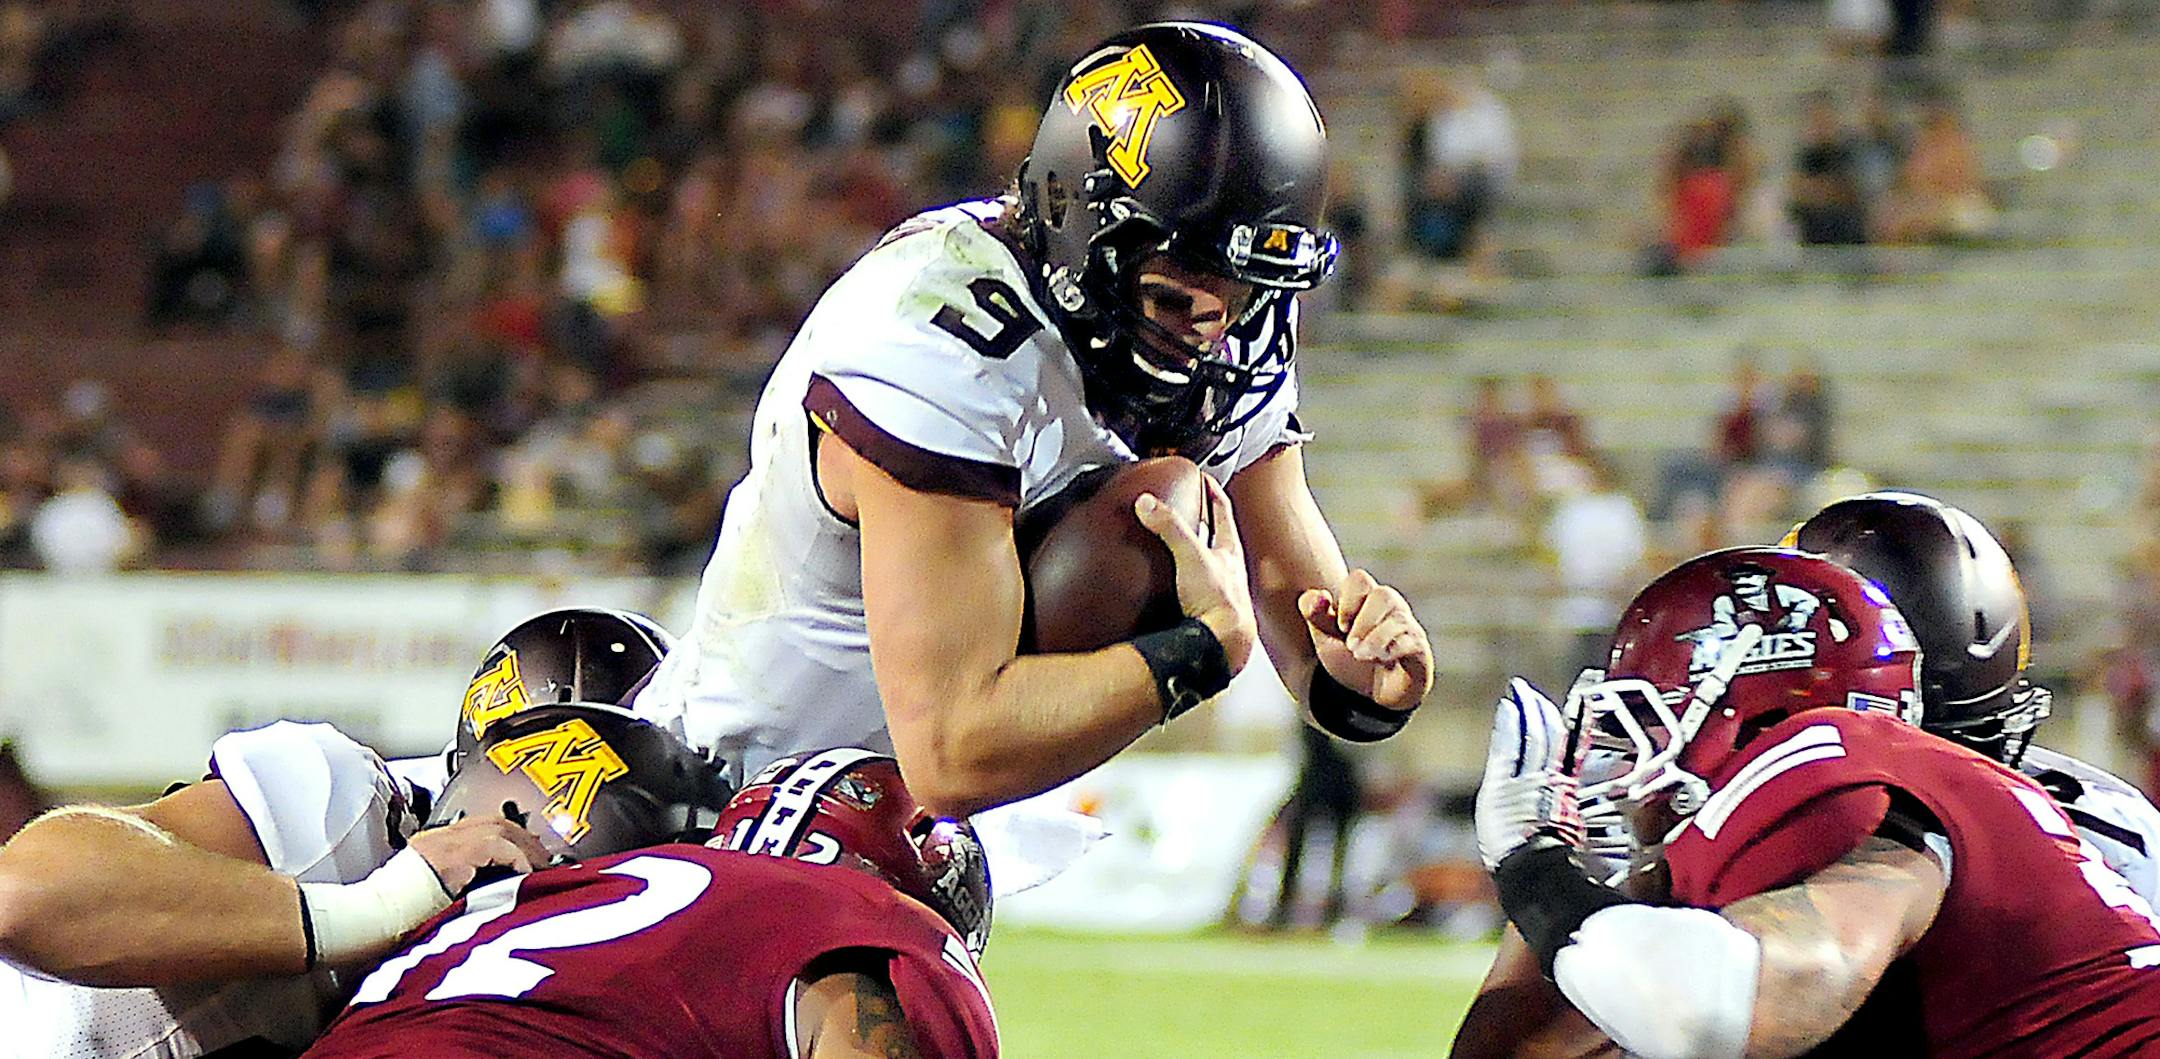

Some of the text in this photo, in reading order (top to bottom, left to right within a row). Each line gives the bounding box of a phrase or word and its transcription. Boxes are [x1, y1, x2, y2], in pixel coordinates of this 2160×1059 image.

[1064, 43, 1186, 190] M
[929, 278, 1046, 360] 9
[486, 728, 630, 846] M
[350, 856, 712, 1005] 12
